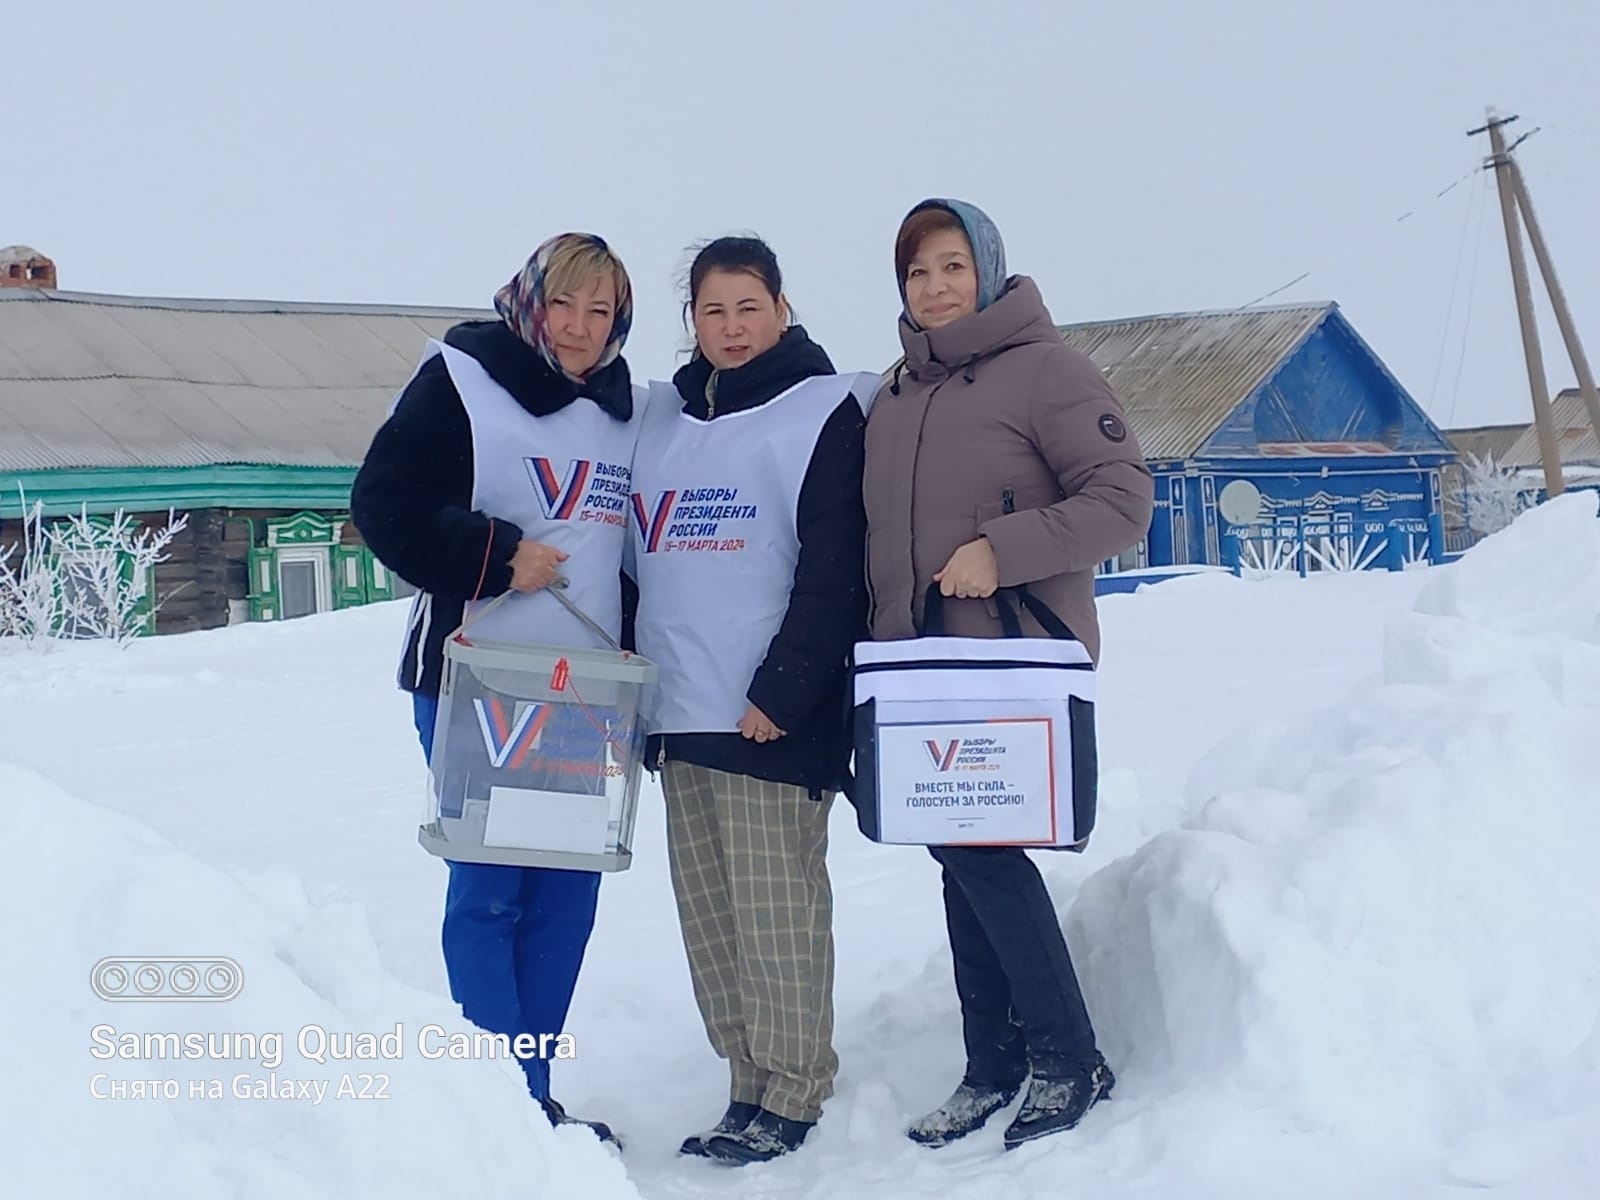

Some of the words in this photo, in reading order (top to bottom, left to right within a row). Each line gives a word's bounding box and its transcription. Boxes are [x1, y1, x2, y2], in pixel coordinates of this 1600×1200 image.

[680, 488, 738, 503] ВЫБОРЫ
[584, 494, 624, 512] РОССИИ
[674, 505, 757, 521] ПРЕЗИДЕНТА
[667, 523, 718, 538] РОССИИ
[685, 539, 718, 552] МАРТА
[720, 539, 745, 551] 2024
[963, 738, 997, 747] ВЫБОРЫ
[956, 756, 986, 764] РОССИИ
[915, 782, 954, 793] ВМЕСТЕ
[957, 781, 975, 792] МЫ
[978, 780, 1005, 791] СИЛА
[906, 796, 959, 808] ГОЛОСУЕМ
[962, 796, 975, 806] ЗА
[977, 794, 1025, 806] РОССИЮ!
